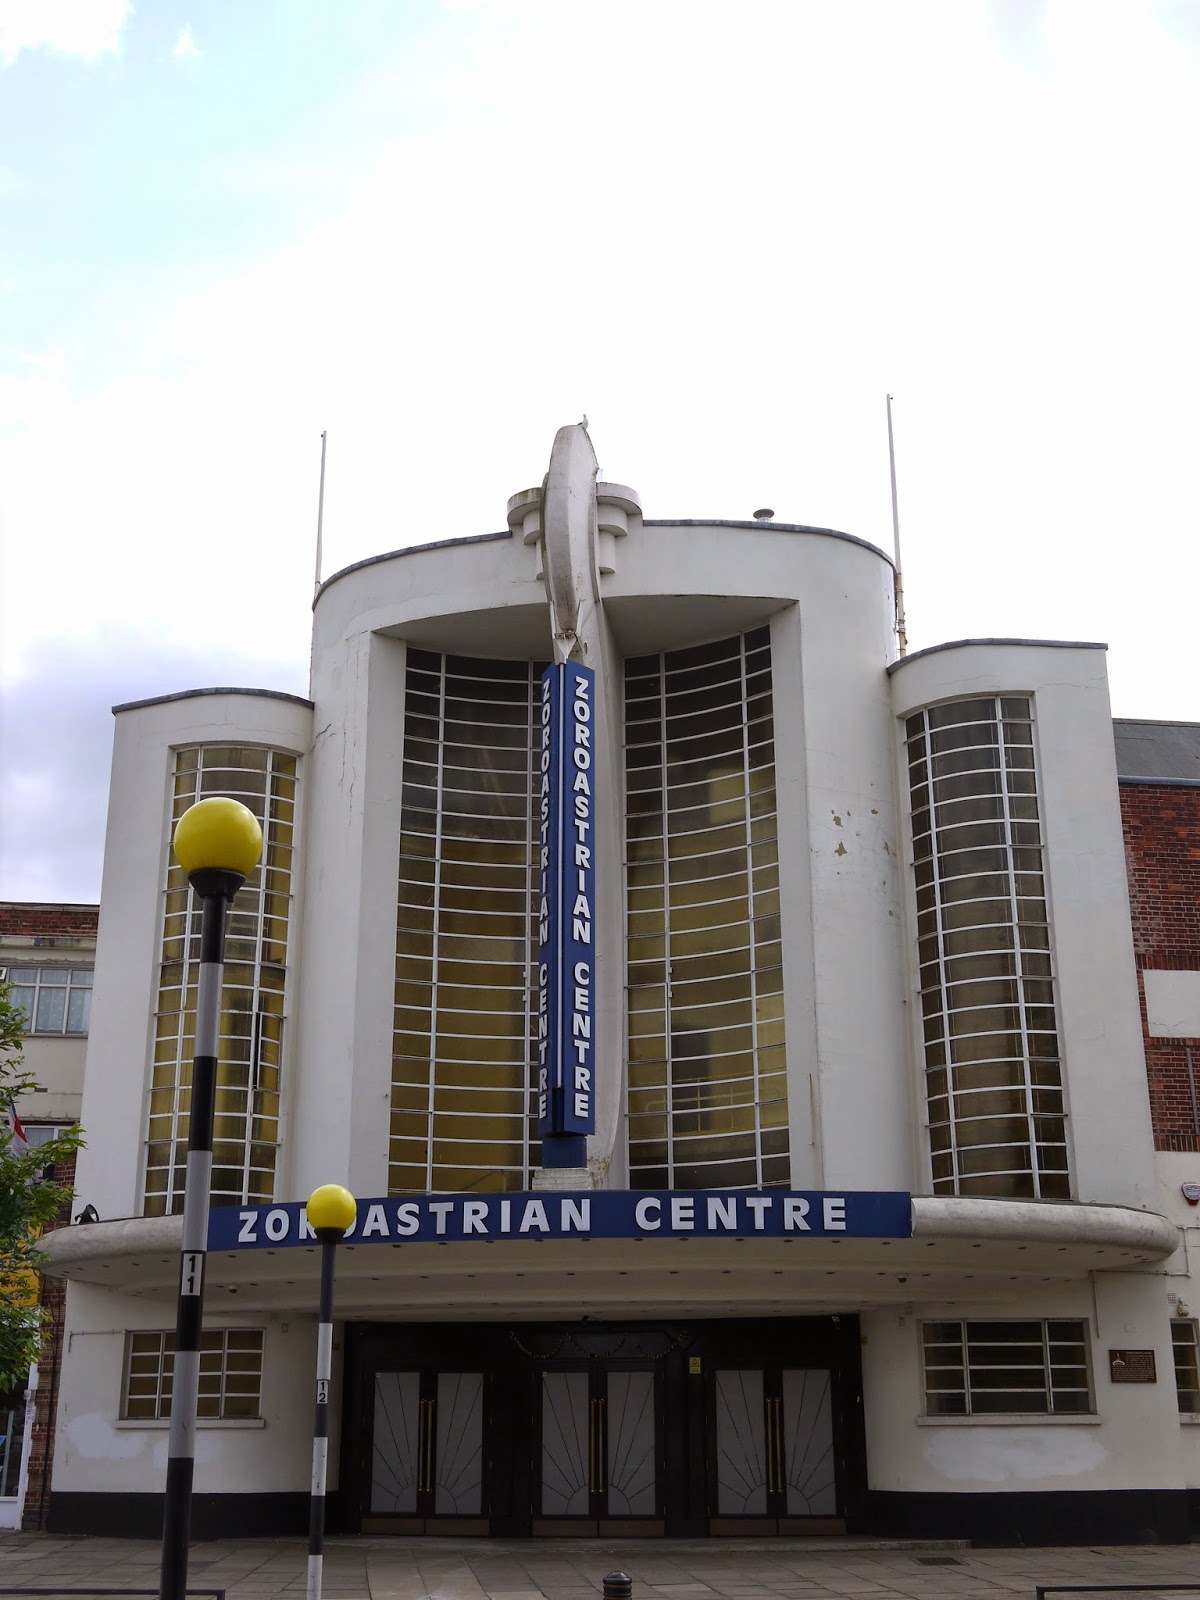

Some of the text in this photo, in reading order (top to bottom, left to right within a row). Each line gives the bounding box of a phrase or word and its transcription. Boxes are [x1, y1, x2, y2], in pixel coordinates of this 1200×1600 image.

[538, 677, 551, 1120] ZOROASTRIAN CENTRE
[573, 675, 591, 1118] ZOROASTRIAN CENTRE
[238, 1197, 847, 1243] ZORASTRIAN CENTRE
